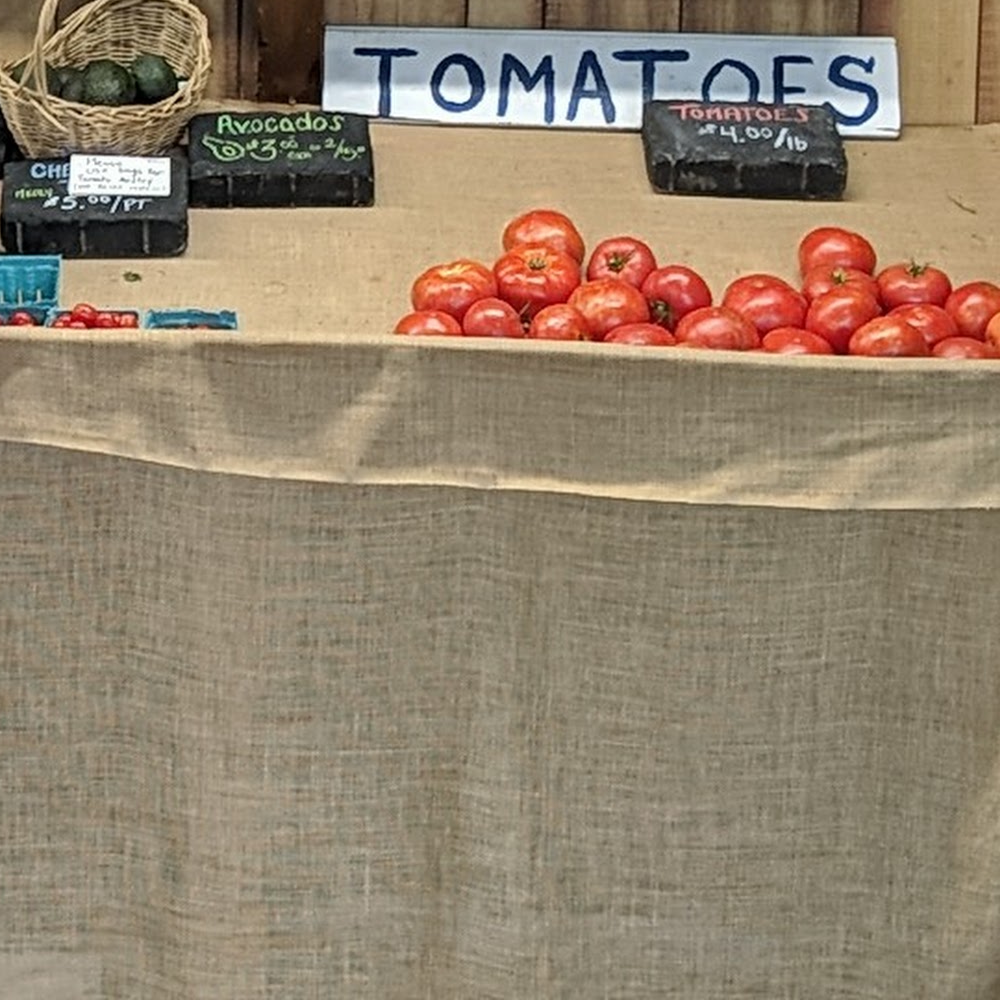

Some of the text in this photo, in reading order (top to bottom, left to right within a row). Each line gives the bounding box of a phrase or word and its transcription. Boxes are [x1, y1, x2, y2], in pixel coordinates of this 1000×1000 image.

[353, 47, 880, 127] TOMATOES
[217, 111, 345, 136] Avocados
[668, 103, 810, 123] TOMATOES
